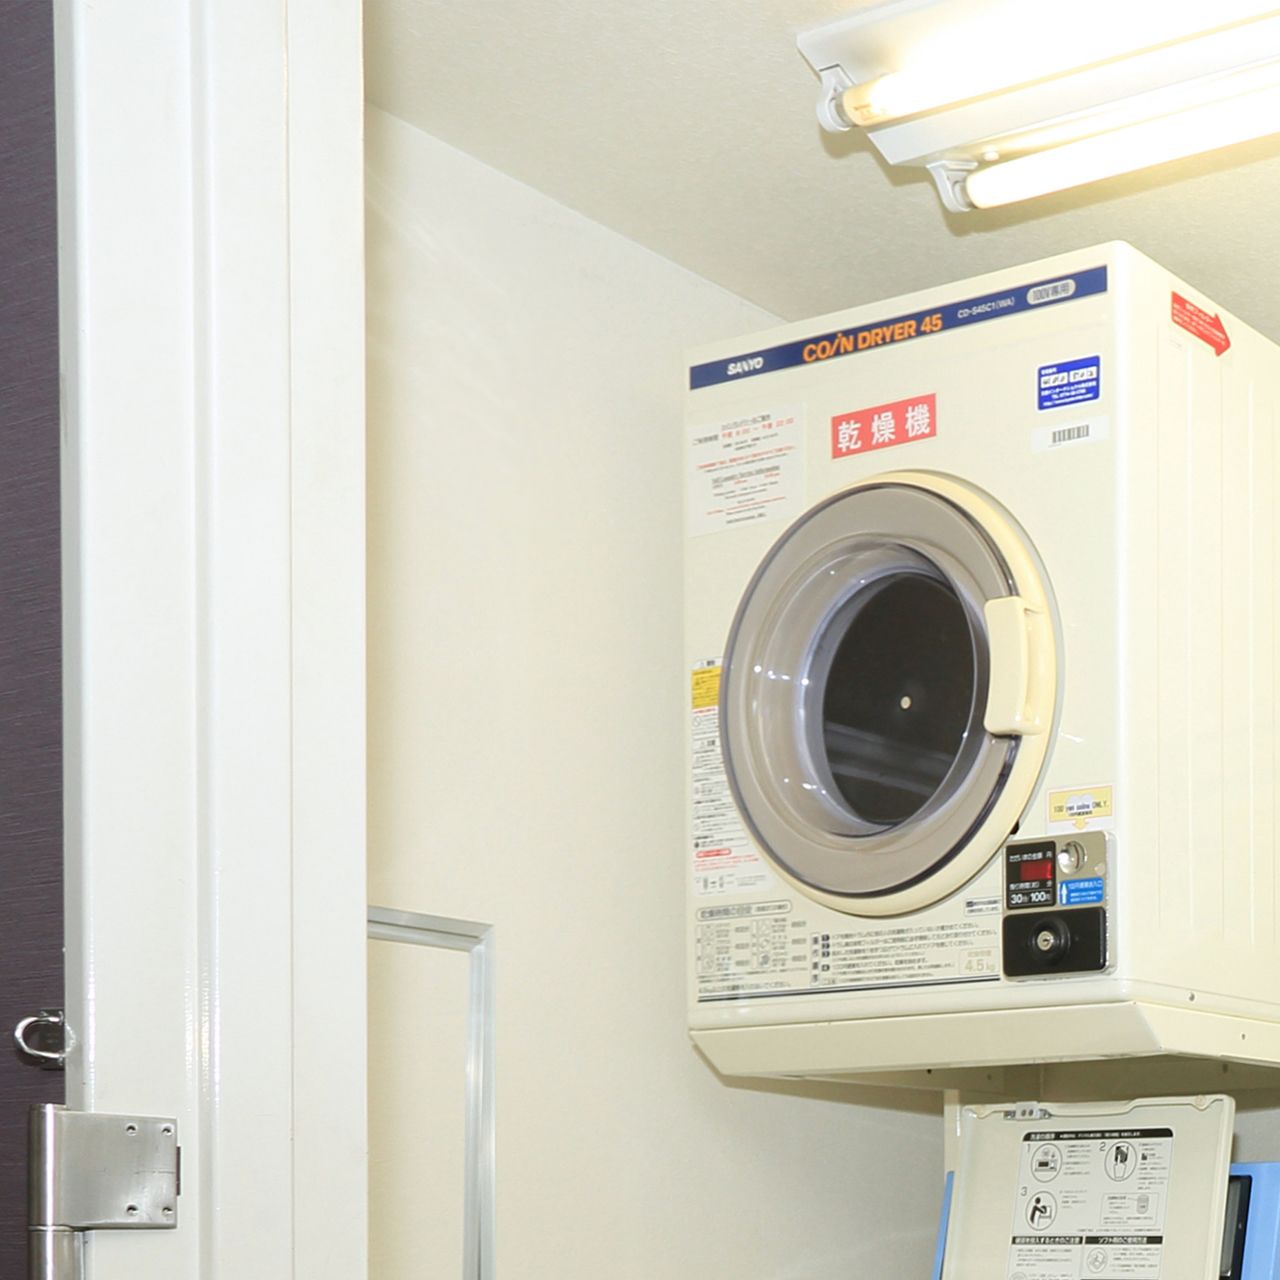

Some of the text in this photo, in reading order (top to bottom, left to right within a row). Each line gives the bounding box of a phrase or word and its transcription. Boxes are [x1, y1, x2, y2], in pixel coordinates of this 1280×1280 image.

[727, 356, 763, 376] SANYO
[857, 319, 917, 352] DRYER
[919, 313, 943, 334] 45
[837, 403, 932, 453] 乾燥機
